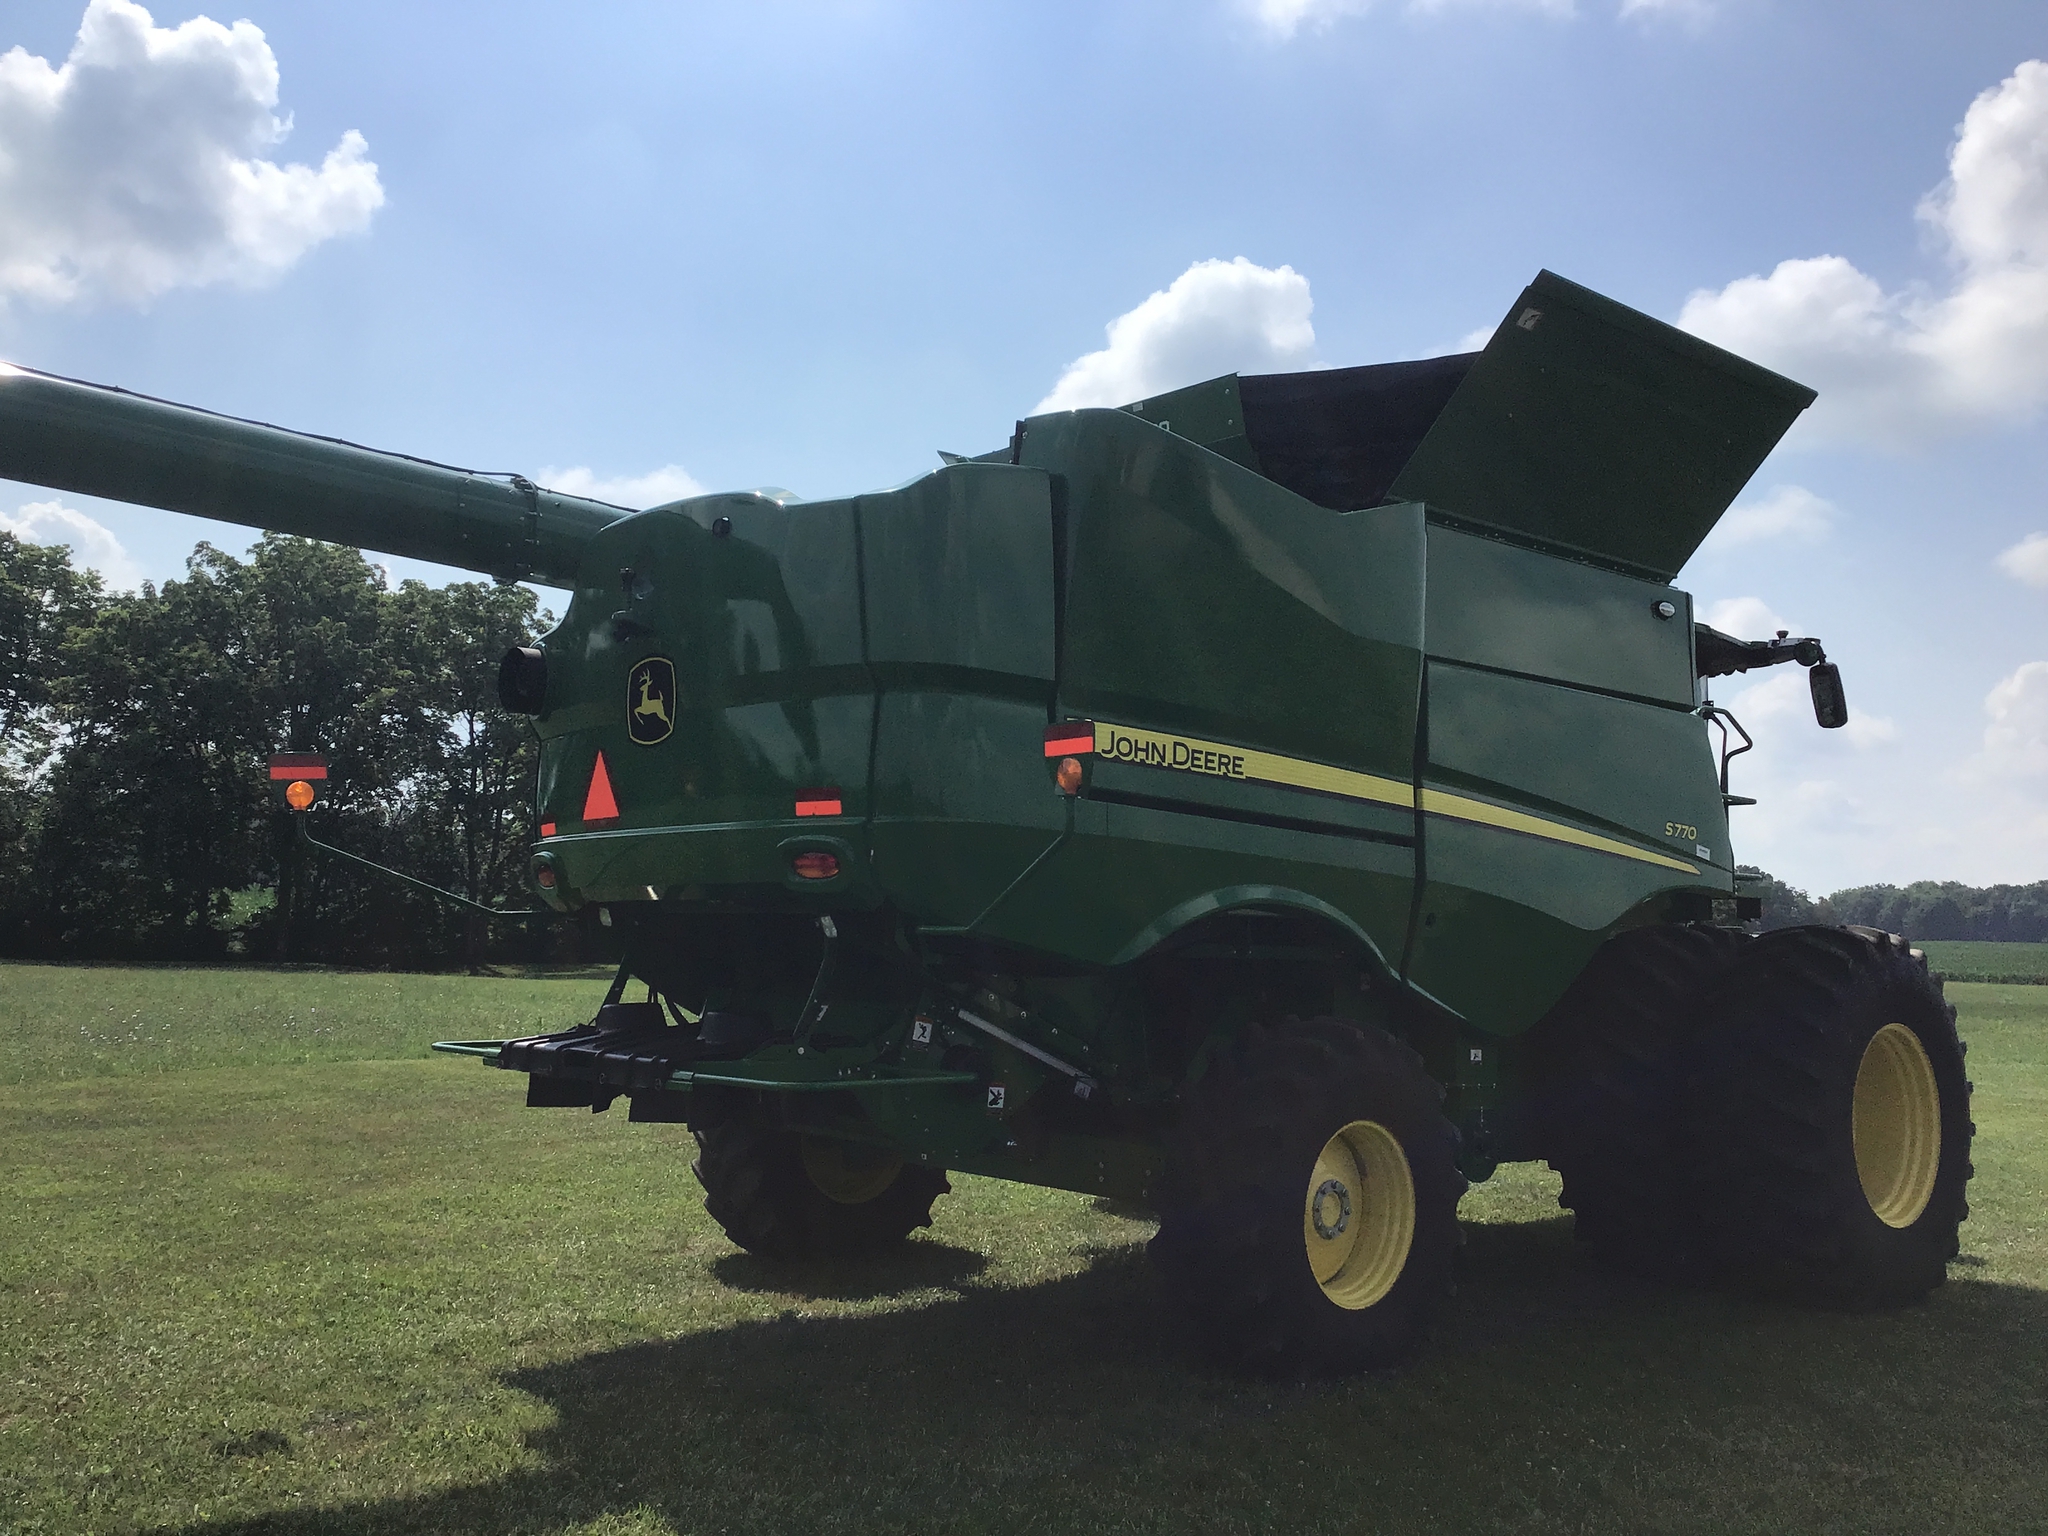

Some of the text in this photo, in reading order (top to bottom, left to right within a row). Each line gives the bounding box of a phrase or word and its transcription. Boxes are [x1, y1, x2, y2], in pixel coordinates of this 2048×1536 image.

[1101, 730, 1246, 777] JOHN DEERE
[1665, 821, 1697, 840] S770
